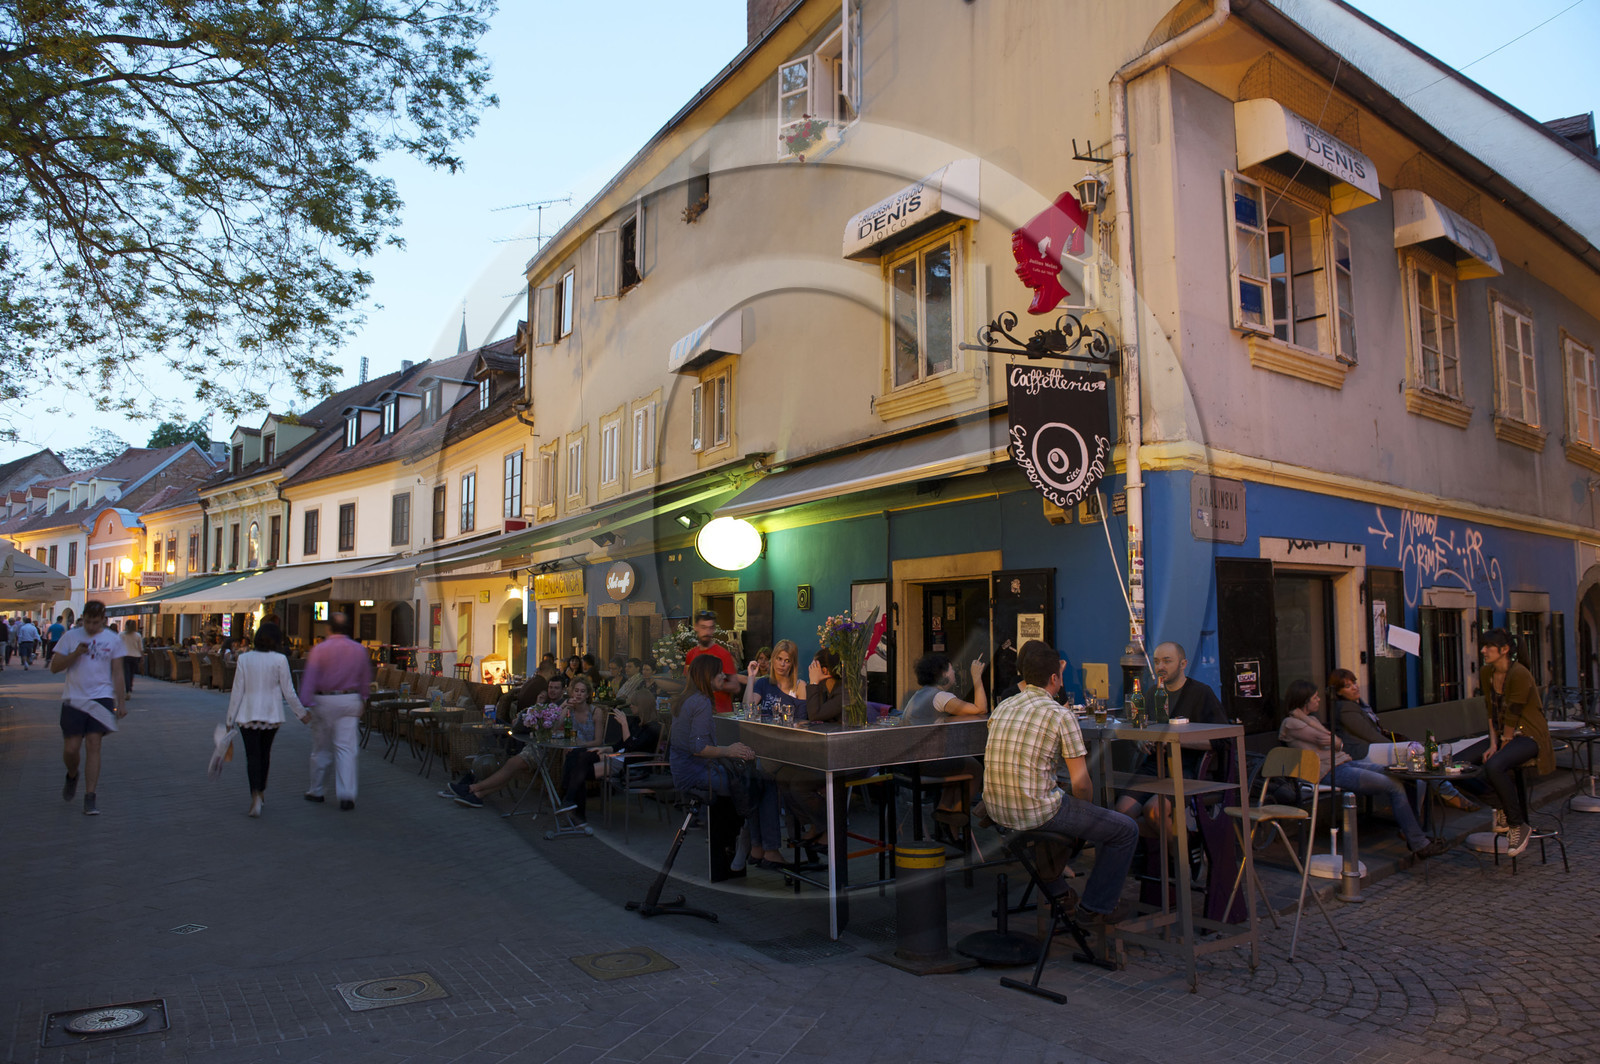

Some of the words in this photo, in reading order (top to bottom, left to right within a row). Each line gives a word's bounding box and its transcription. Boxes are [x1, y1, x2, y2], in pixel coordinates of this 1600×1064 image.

[1305, 133, 1366, 179] DENIS
[1319, 159, 1355, 184] JOICO
[896, 183, 924, 206] STUDIO
[857, 195, 921, 241] DENIS
[869, 218, 907, 244] JOICO
[1010, 367, 1095, 395] Caffetteria
[1066, 467, 1082, 483] cica
[1086, 494, 1099, 515] 18
[1199, 487, 1239, 512] SKALINSKA
[1239, 674, 1255, 682] ESCAPE
